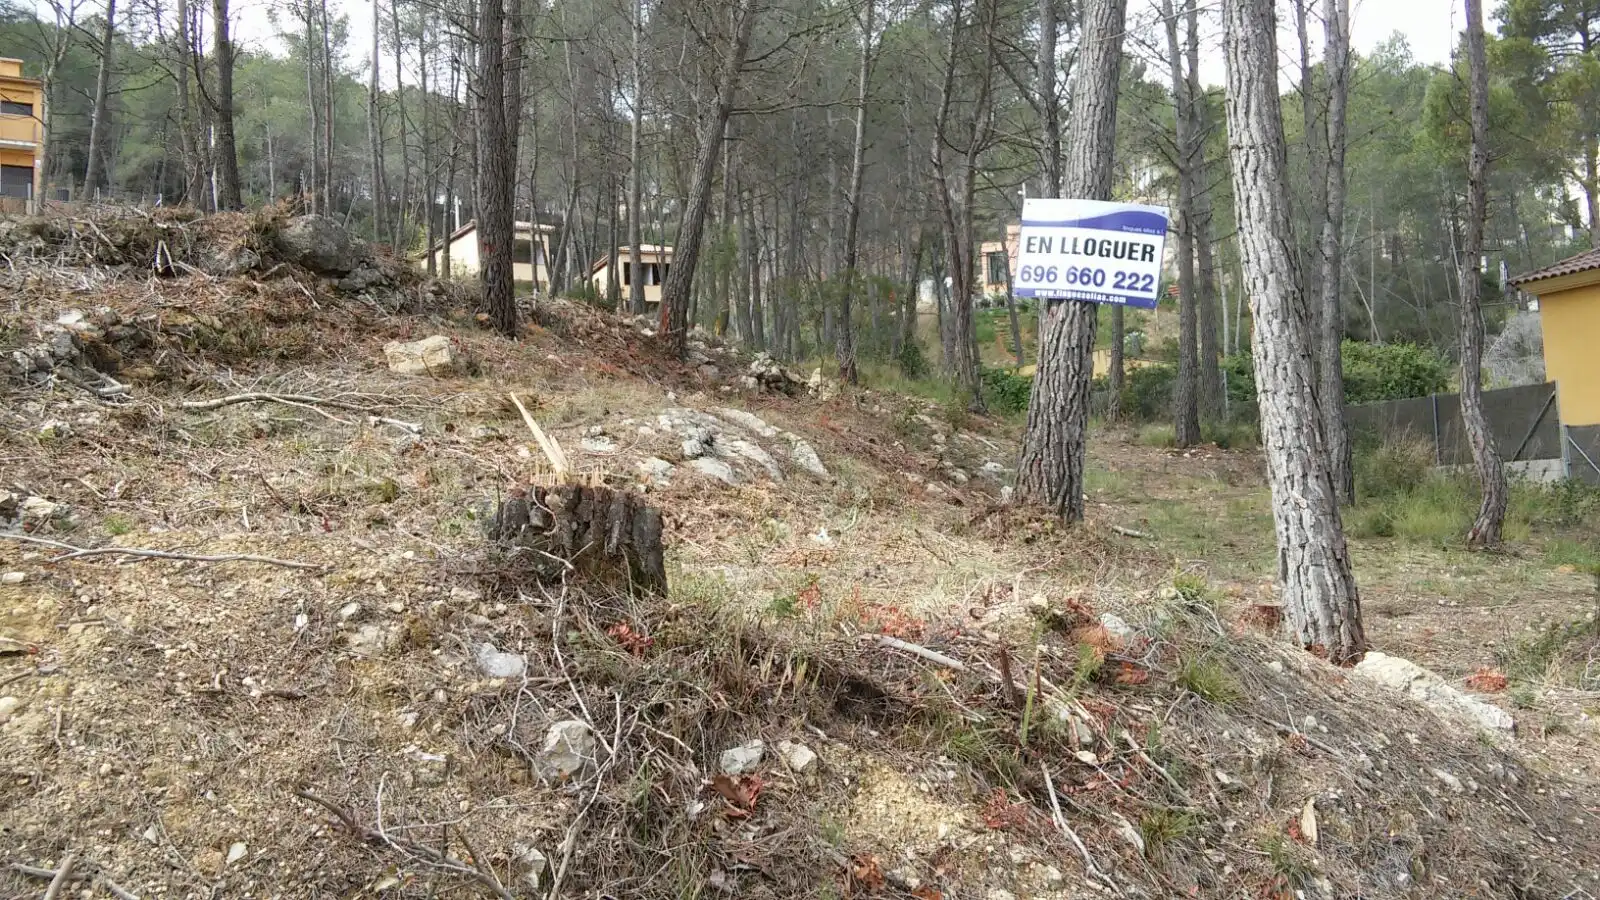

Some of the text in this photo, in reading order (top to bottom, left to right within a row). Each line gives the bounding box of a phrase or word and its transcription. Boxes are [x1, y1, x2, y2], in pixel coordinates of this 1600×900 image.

[1026, 236, 1155, 262] EN LLOGUER
[1020, 265, 1154, 292] 696 660 222
